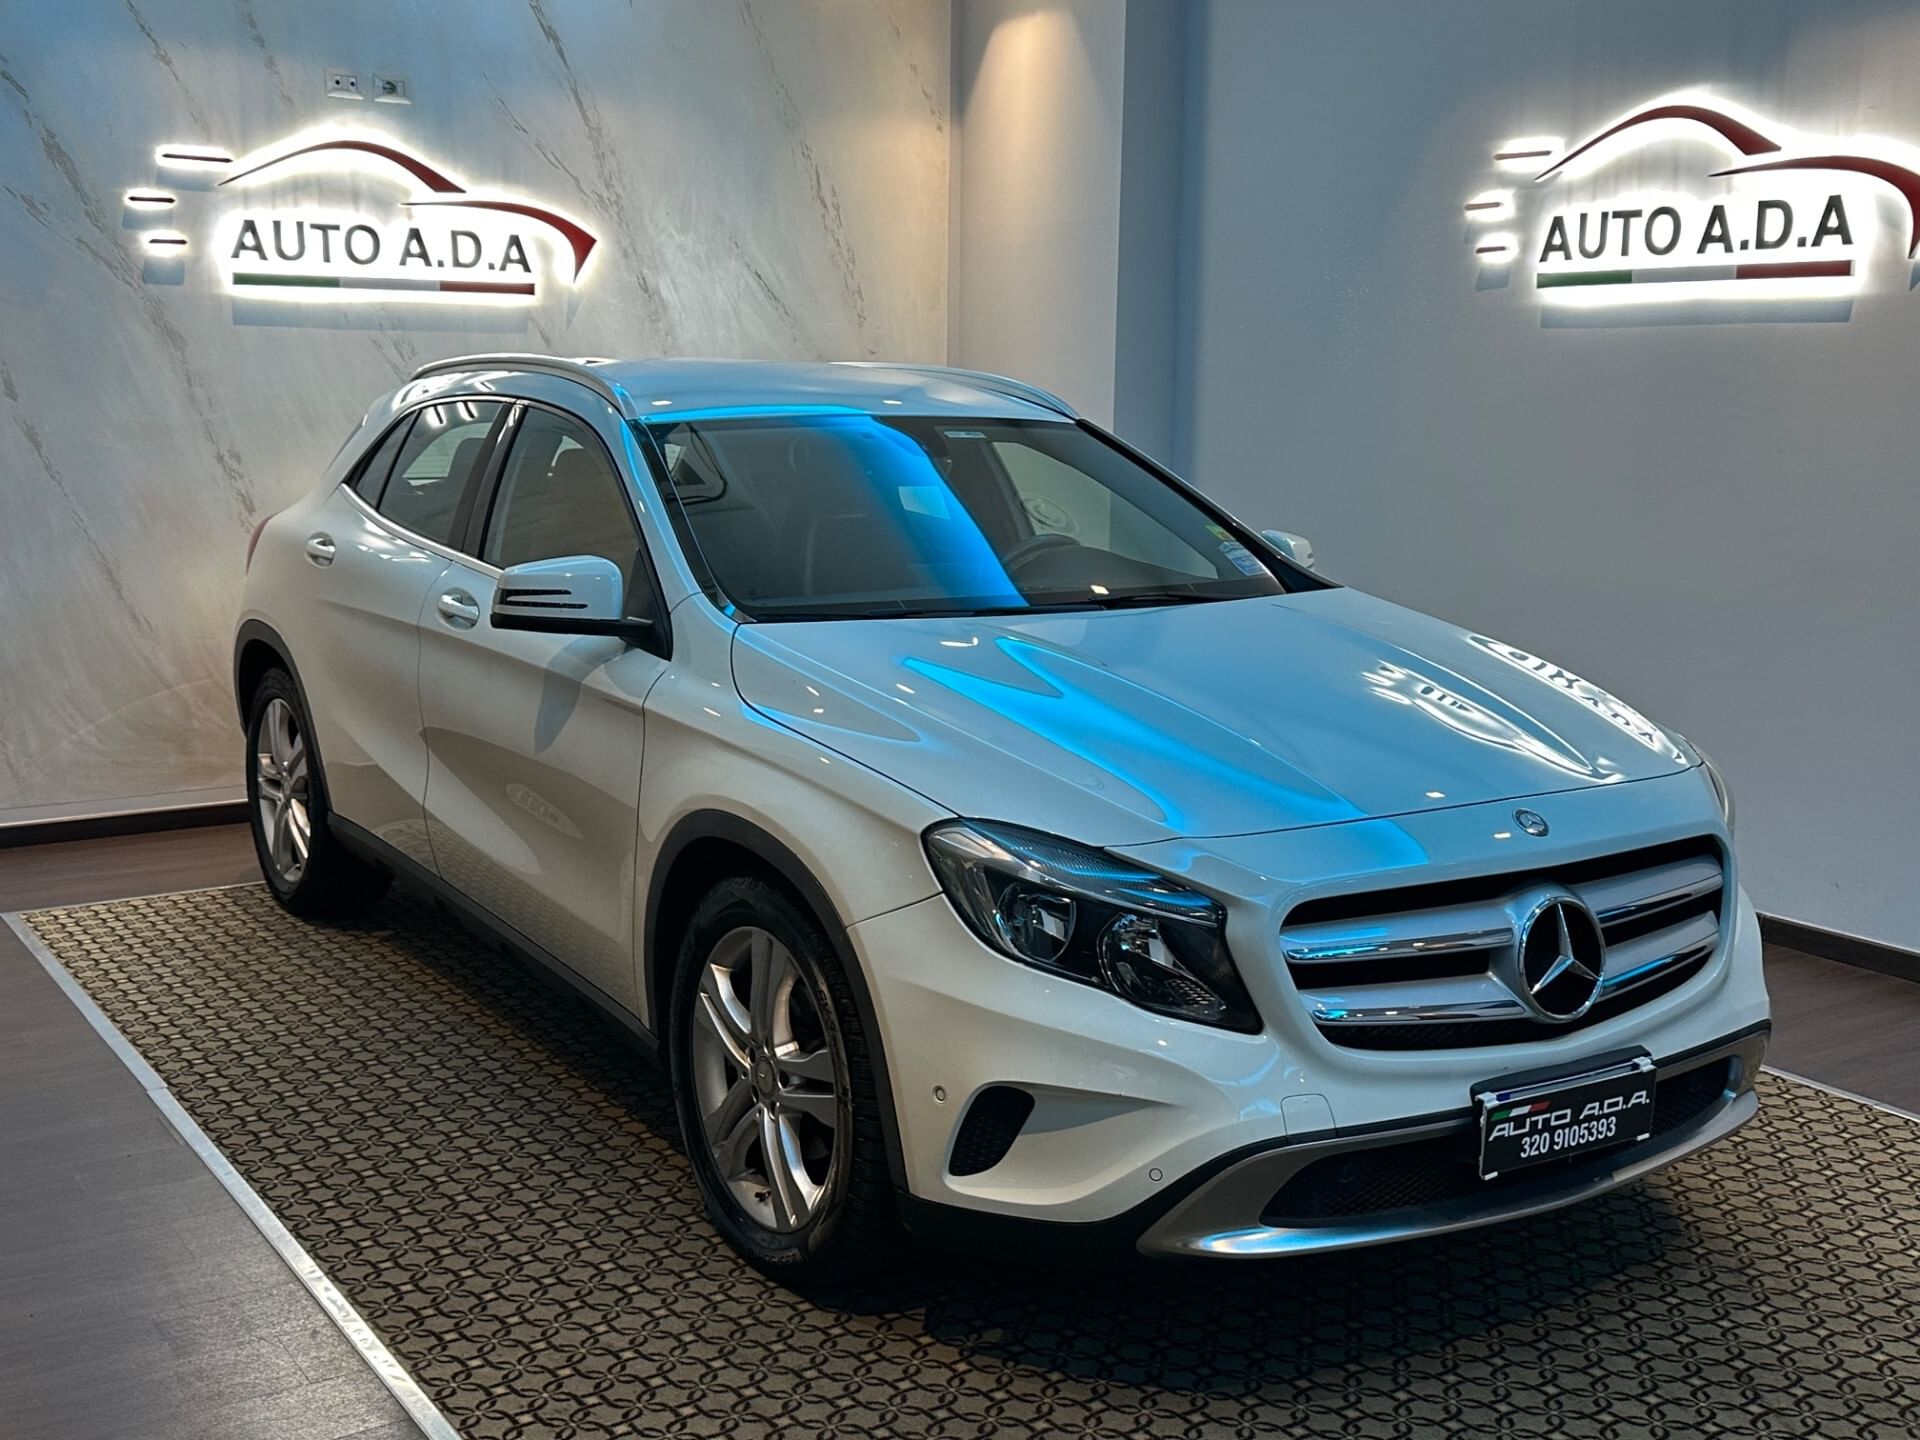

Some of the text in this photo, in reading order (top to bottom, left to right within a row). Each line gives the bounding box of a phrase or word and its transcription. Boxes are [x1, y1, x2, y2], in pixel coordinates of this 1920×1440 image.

[231, 219, 532, 272] AUTO A.D.A
[1539, 194, 1854, 262] AUTO A.D.A
[1488, 1090, 1650, 1142] AUTO A.D.A.
[1520, 1117, 1617, 1159] 320 9105393
